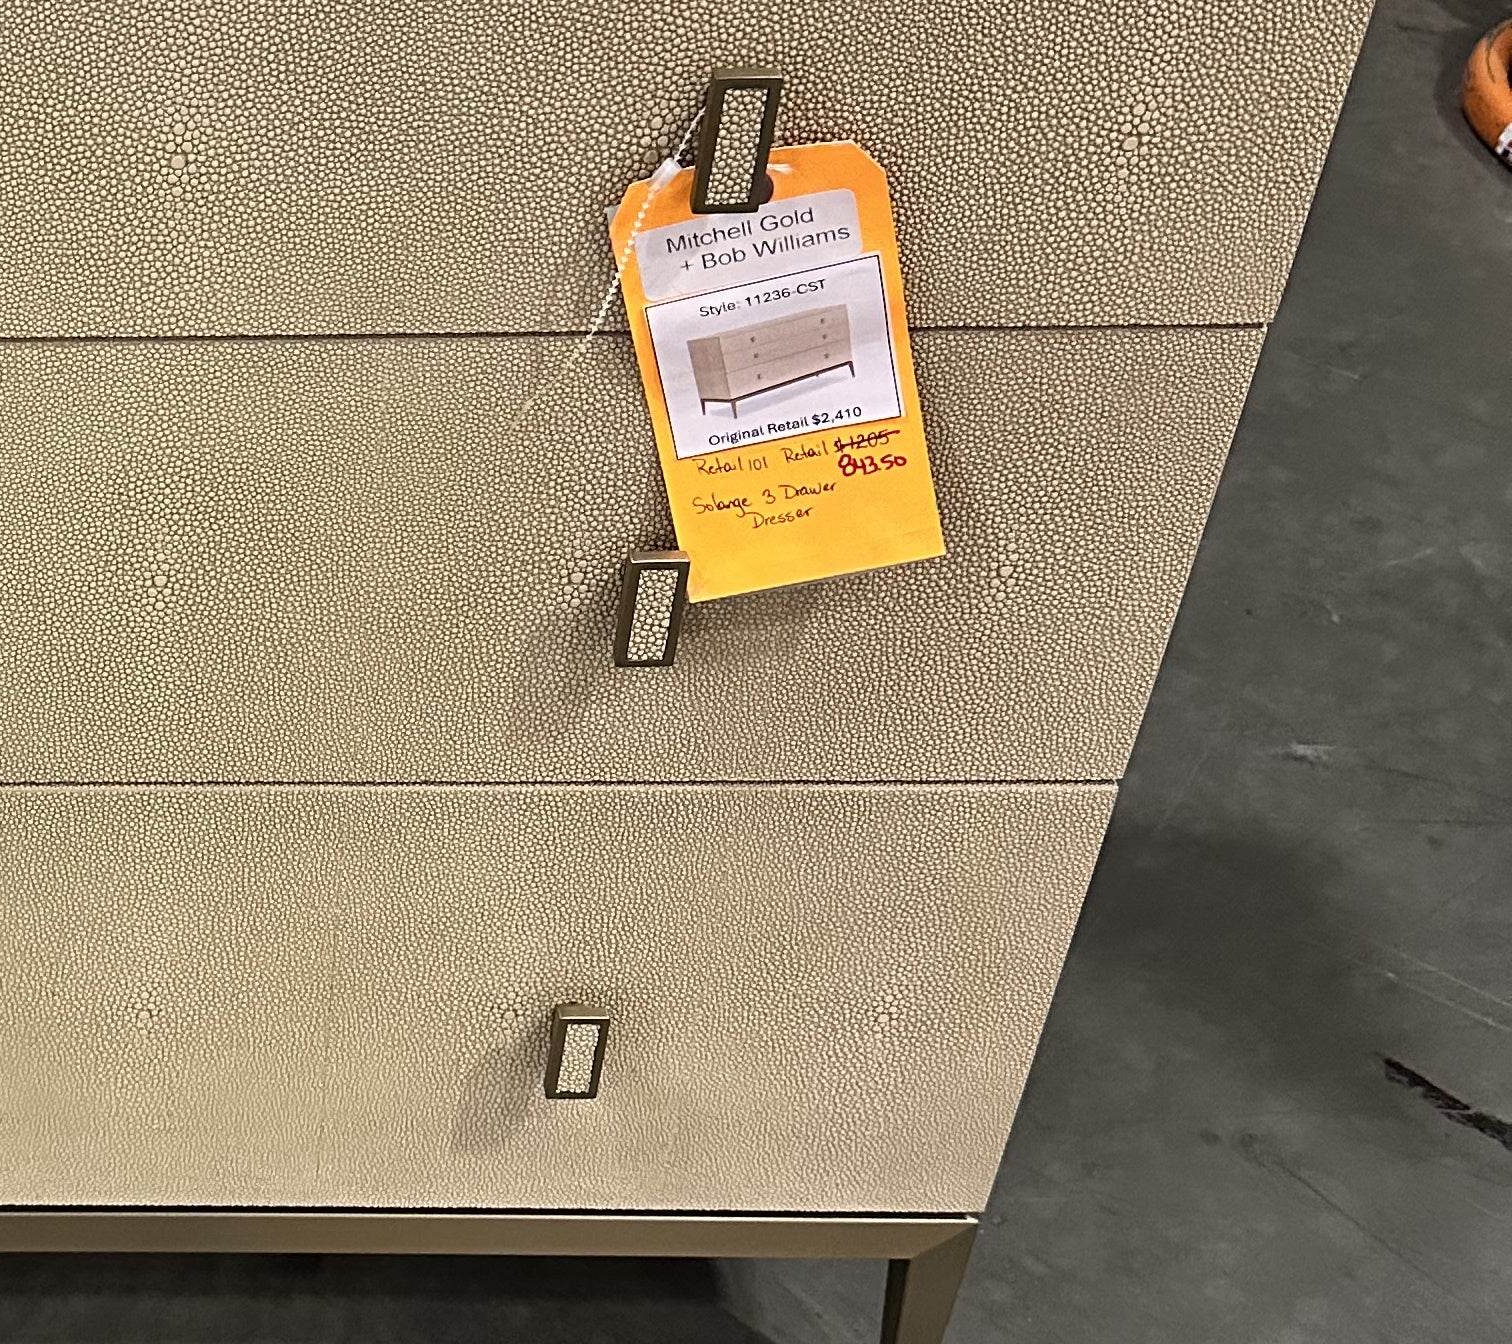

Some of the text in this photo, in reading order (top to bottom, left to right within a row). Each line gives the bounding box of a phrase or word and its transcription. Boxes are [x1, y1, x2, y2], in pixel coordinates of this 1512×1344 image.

[666, 207, 814, 253] Mitchell Gold
[680, 227, 850, 272] + Bob Williams
[699, 278, 826, 317] Style: 11236-CST
[708, 406, 862, 446] Original Retail $2,410
[692, 458, 743, 475] Retail
[780, 439, 829, 463] Retail
[692, 481, 837, 517] Solange 3 Drawer
[746, 507, 814, 529] Dresser
